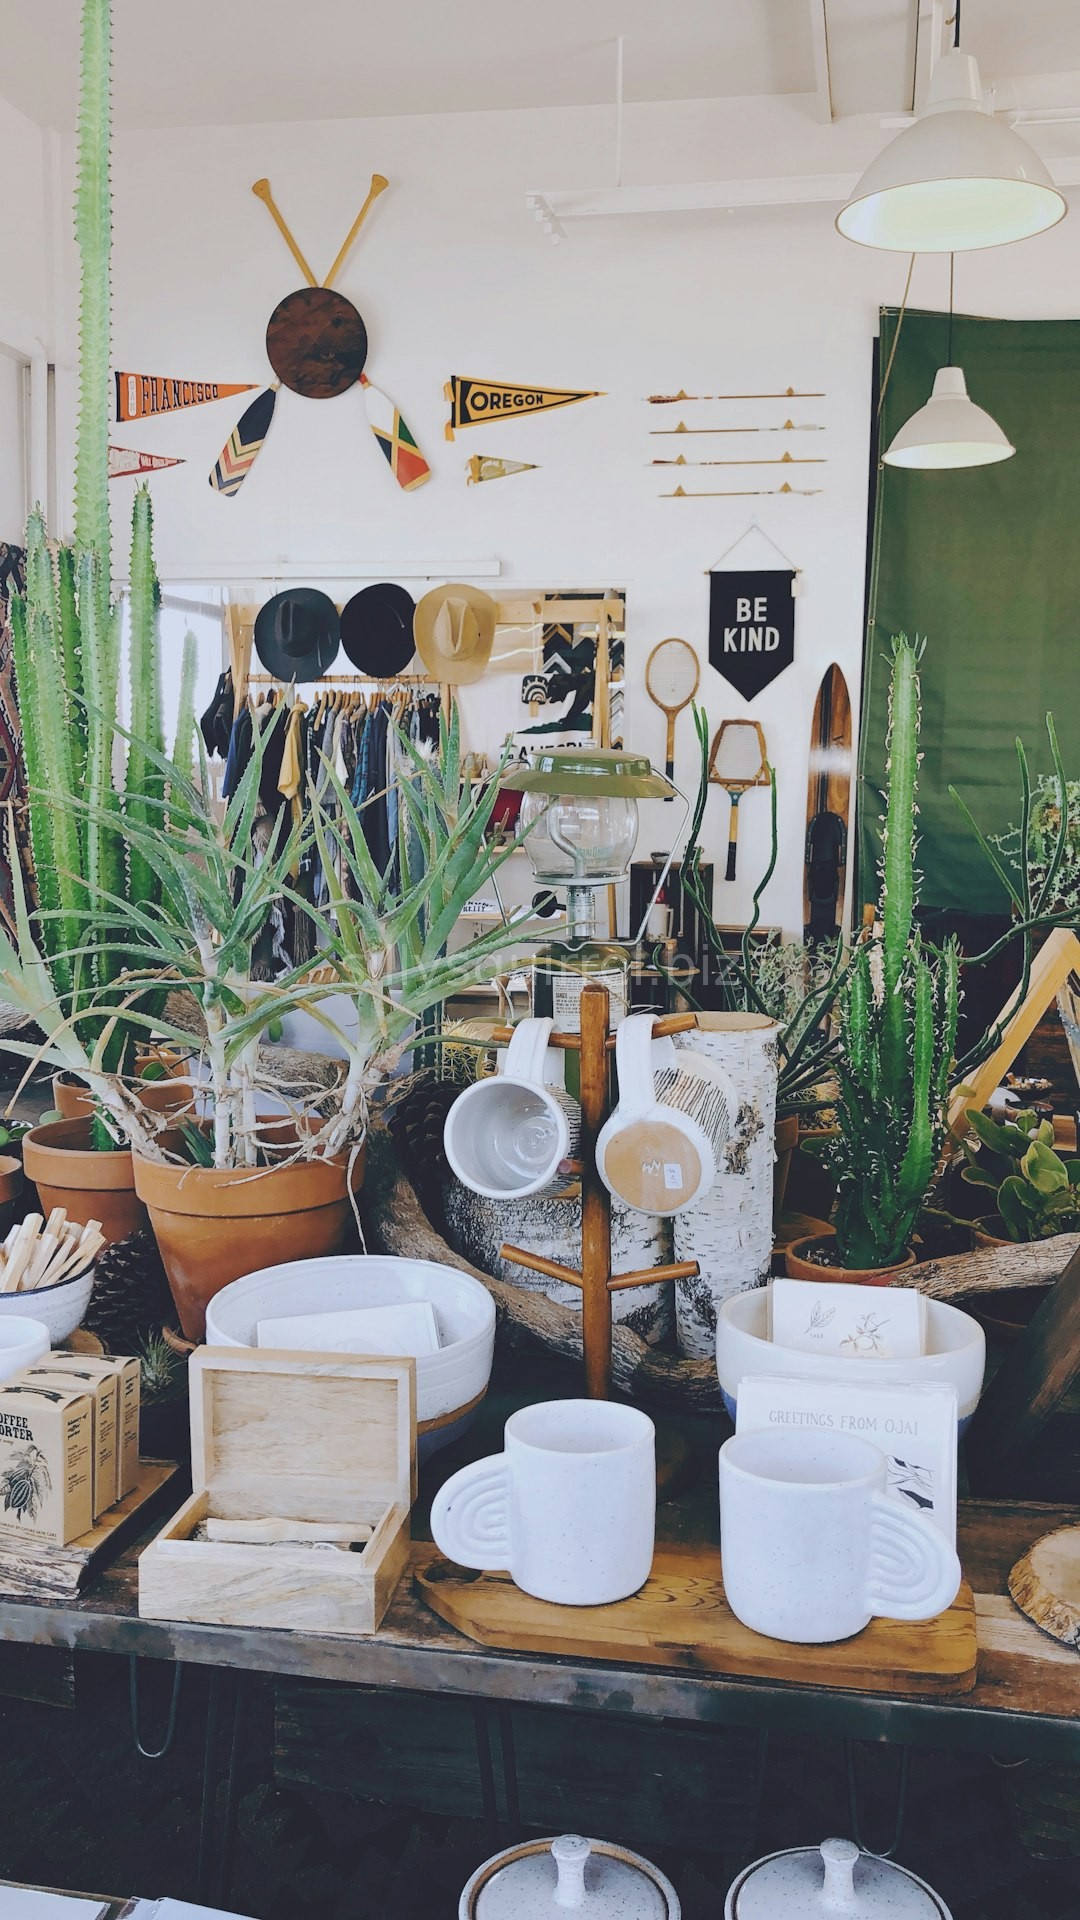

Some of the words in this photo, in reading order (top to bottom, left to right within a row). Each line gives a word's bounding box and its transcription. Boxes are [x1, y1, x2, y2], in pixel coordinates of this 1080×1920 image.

[140, 375, 219, 416] FRANCISCO
[470, 391, 543, 411] OREGON
[736, 597, 768, 622] BE
[723, 627, 780, 653] KIND
[0, 1412, 28, 1428] OFFEE
[0, 1424, 34, 1441] ORTER
[769, 1410, 834, 1427] GREETINGS
[840, 1415, 877, 1431] FROM
[884, 1418, 918, 1436] OJAI
